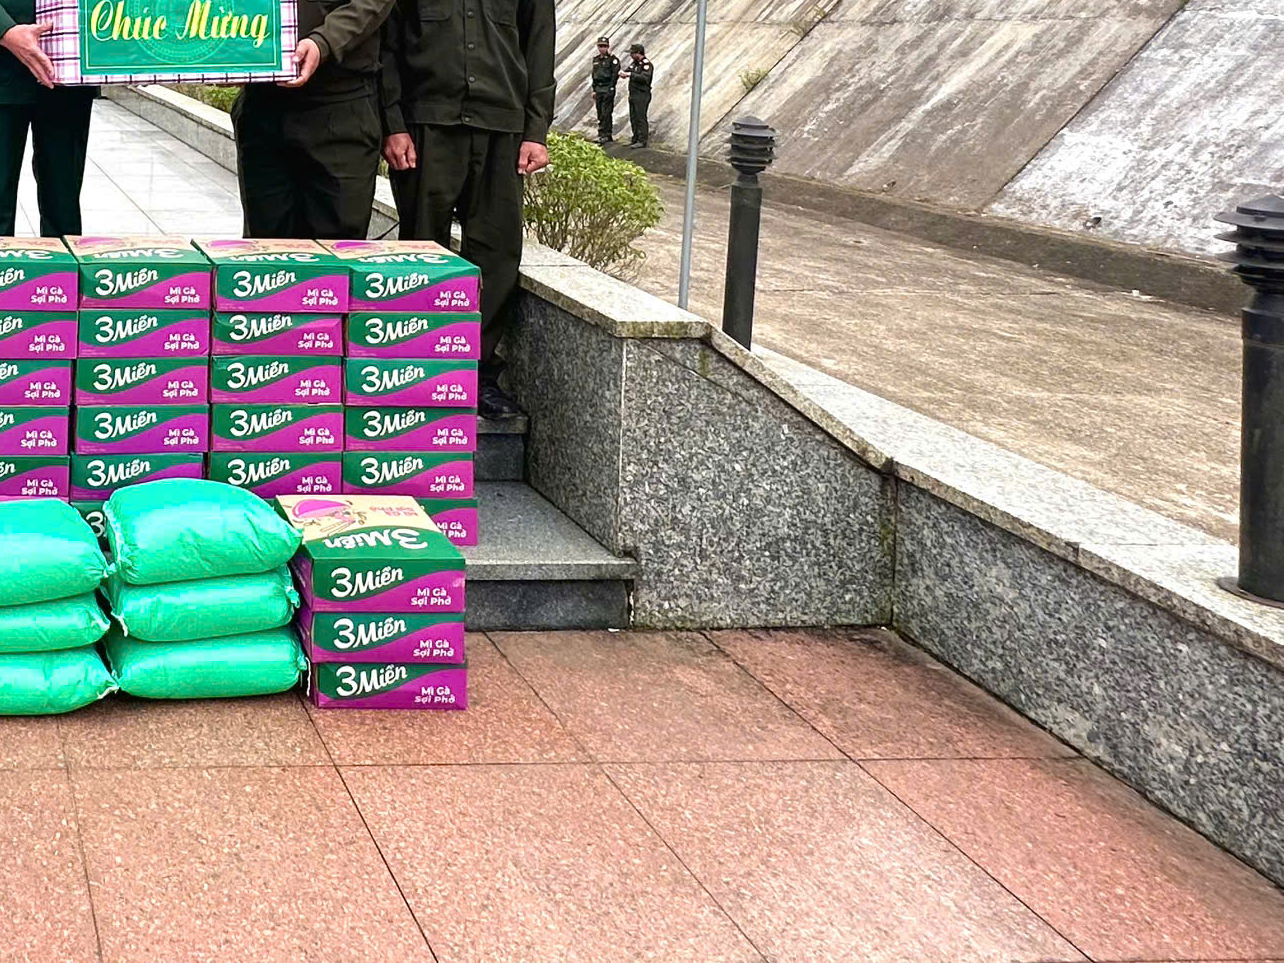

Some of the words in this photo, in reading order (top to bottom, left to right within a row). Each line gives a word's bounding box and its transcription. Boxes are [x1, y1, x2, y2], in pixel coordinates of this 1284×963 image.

[91, 0, 166, 41] Chúc
[181, 294, 200, 303] Phở
[452, 298, 469, 306] Phở
[40, 389, 60, 397] Phở
[312, 387, 330, 396] Phở
[449, 436, 467, 444] Phở
[417, 588, 429, 596] Mì
[432, 588, 447, 596] Gà
[411, 597, 427, 606] Sợi
[430, 597, 451, 605] Phở
[420, 640, 432, 648] Mì
[435, 640, 449, 648] Gà
[413, 649, 430, 657] Sợi
[433, 648, 454, 657] Phở
[421, 687, 434, 695] Mì
[436, 687, 451, 695] Gà
[414, 696, 431, 704] Sợi
[434, 695, 456, 703] Phở
